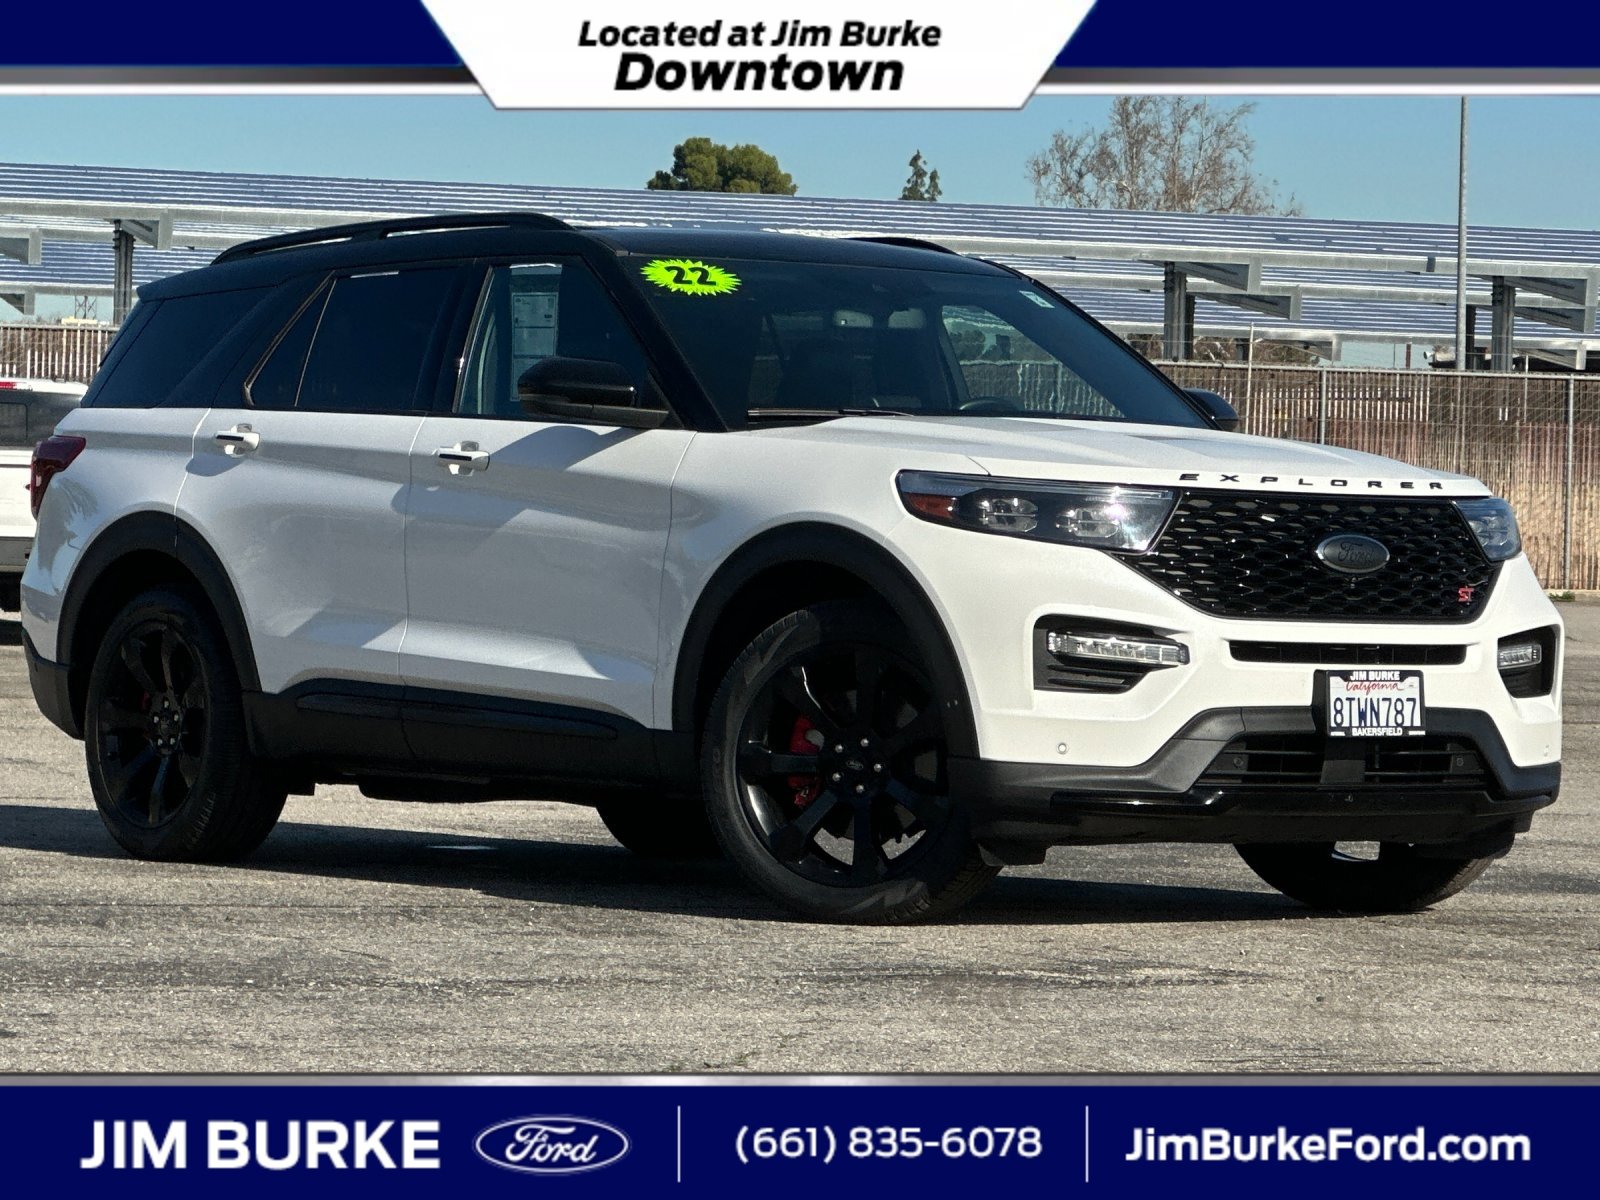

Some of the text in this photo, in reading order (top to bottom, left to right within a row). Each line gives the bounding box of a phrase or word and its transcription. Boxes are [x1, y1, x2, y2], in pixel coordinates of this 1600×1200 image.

[664, 265, 717, 287] 22
[1179, 473, 1443, 490] EXPLORER
[1458, 587, 1474, 602] ST
[1350, 671, 1400, 681] JIM BURKE
[1345, 681, 1404, 696] California
[1333, 697, 1417, 727] 8TWN787
[1352, 727, 1403, 737] BAKERSFIELD
